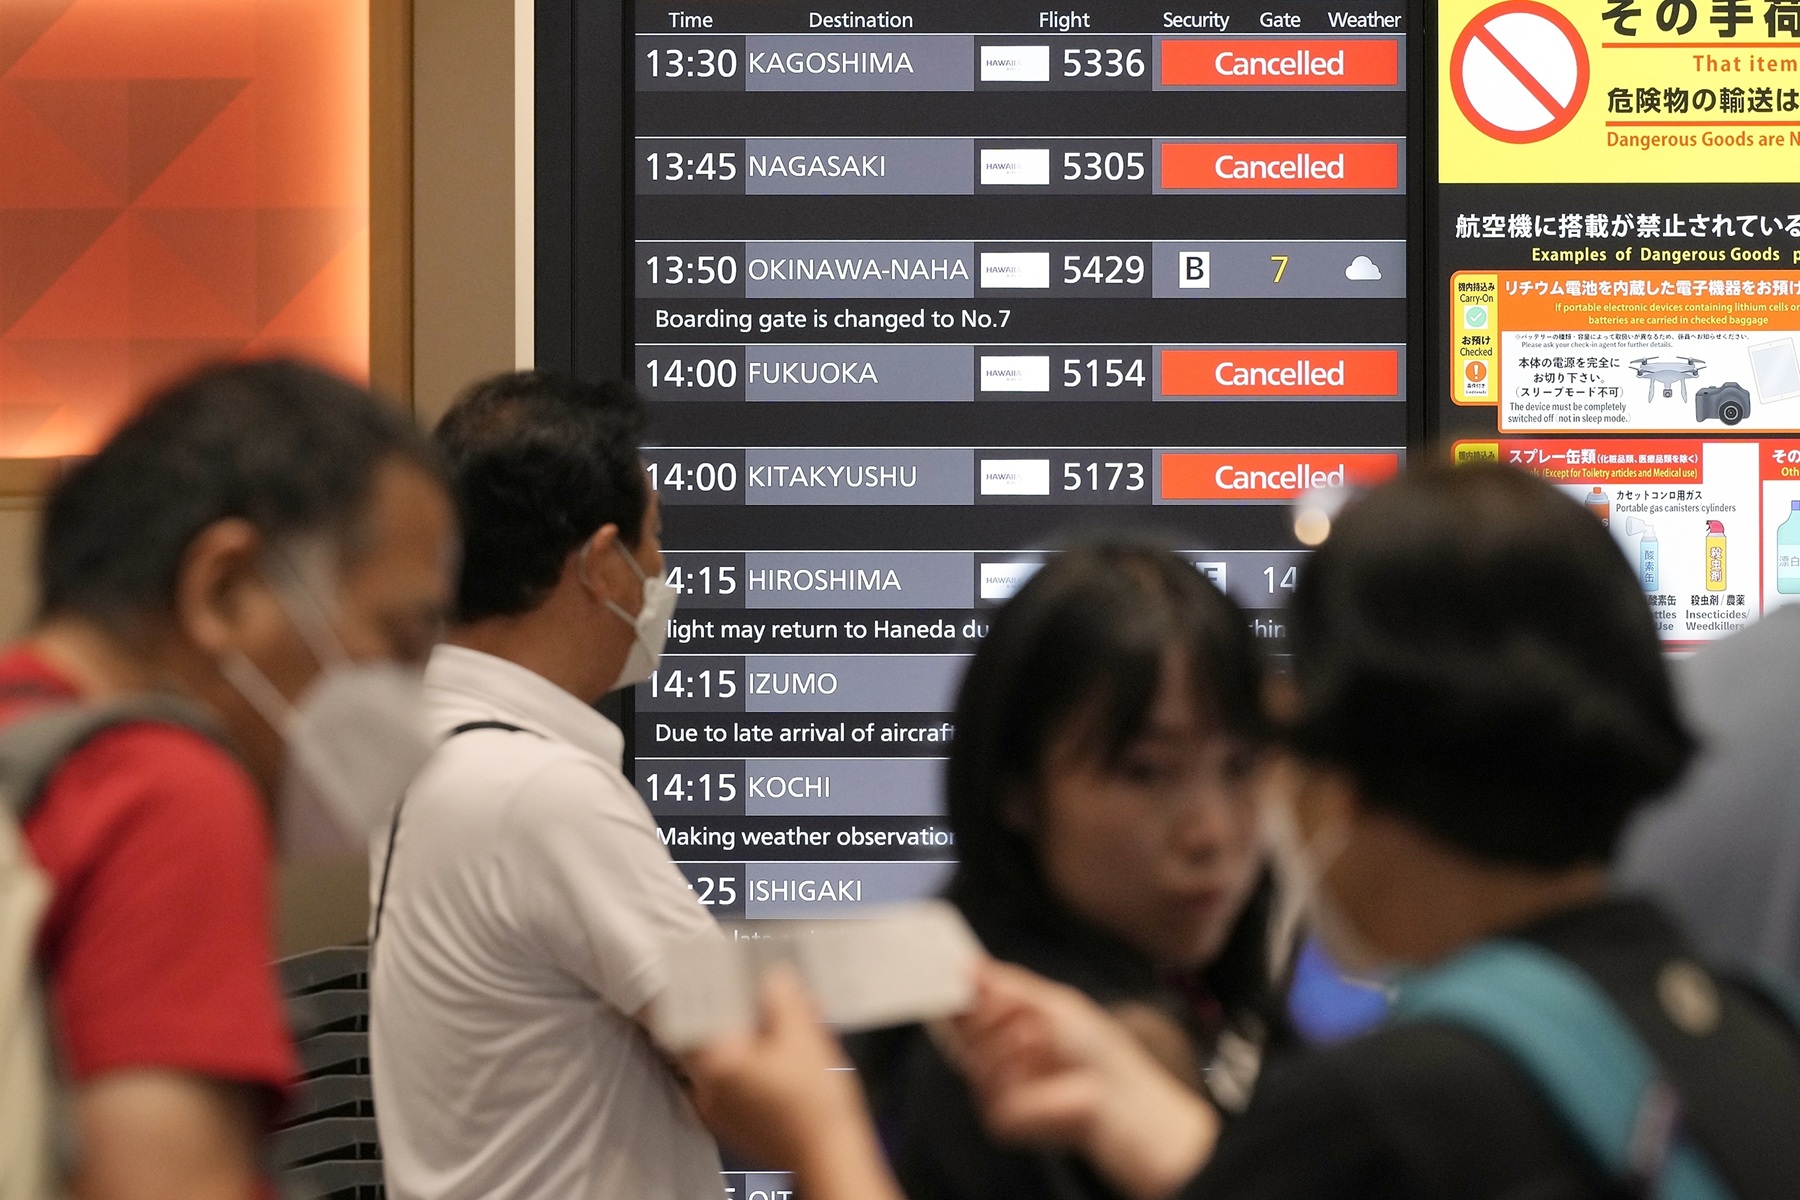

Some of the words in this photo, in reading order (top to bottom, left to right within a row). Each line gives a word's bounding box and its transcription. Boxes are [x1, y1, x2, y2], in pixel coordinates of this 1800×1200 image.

[669, 12, 713, 27] Time
[810, 12, 912, 27] Destination
[1040, 11, 1090, 31] Flight
[1164, 11, 1229, 31] Security
[1260, 12, 1300, 27] Gate
[1328, 11, 1401, 27] Weather
[1602, 0, 1800, 38] その手荷
[647, 50, 736, 77] 13:30
[750, 53, 913, 73] KAGOSHIMA
[1064, 49, 1144, 76] 5336
[1216, 50, 1343, 75] Cancelled
[1693, 55, 1740, 72] That
[1751, 55, 1797, 71] item
[1608, 87, 1799, 113] 危険物の輸送は
[1608, 132, 1696, 150] Dangerous
[1702, 131, 1753, 146] Goods
[1759, 135, 1784, 146] are
[647, 153, 736, 180] 13:45
[750, 156, 884, 176] NAGASAKI
[1064, 152, 1144, 180] 5305
[1216, 154, 1343, 178] Cancelled
[1456, 213, 1800, 238] 航空機に搭載が禁止されている
[1533, 247, 1606, 264] Examples
[1616, 247, 1632, 261] of
[1641, 248, 1725, 264] Dangerous
[1731, 247, 1779, 260] Goods
[647, 256, 736, 284] 13:50
[749, 259, 969, 280] OKINAWA-NAHA
[1064, 256, 1144, 283] 5429
[1184, 256, 1206, 282] B
[1272, 255, 1288, 283] 7
[1458, 282, 1495, 292] 機内持込み
[1460, 294, 1494, 305] Carry-On
[1555, 303, 1562, 312] If
[1564, 303, 1602, 314] portable
[1603, 303, 1648, 312] electronic
[1649, 303, 1683, 312] devices
[1685, 303, 1733, 314] containing
[1735, 303, 1767, 312] lithium
[1769, 303, 1789, 312] cells
[657, 309, 751, 332] Boarding
[759, 311, 806, 332] gate
[814, 309, 827, 327] is
[834, 309, 924, 332] changed
[931, 311, 954, 327] to
[962, 310, 1010, 327] No.7
[1588, 316, 1629, 325] batteries
[1647, 316, 1678, 325] carried
[1680, 316, 1689, 325] in
[1691, 316, 1728, 325] checked
[1729, 316, 1769, 327] baggage
[1461, 336, 1491, 346] お預け
[1460, 347, 1492, 356] Checked
[1518, 357, 1620, 369] 本体の電源を完全に
[647, 360, 736, 387] 14:00
[750, 363, 878, 383] FUKUOKA
[1064, 360, 1145, 386] 5154
[1216, 361, 1343, 385] Cancelled
[1533, 372, 1605, 384] お切り下さい。
[1510, 402, 1524, 411] The
[1525, 402, 1550, 411] device
[1552, 403, 1572, 411] must
[1573, 402, 1582, 411] be
[1584, 402, 1626, 413] completely
[1508, 414, 1542, 423] switched
[1543, 414, 1554, 423] off
[1573, 414, 1581, 423] in
[1582, 414, 1603, 424] sleep
[1509, 448, 1597, 464] スプレー缶類
[647, 463, 736, 491] 14:00
[750, 466, 916, 486] KITAKYUSHU
[1064, 463, 1144, 490] 5173
[1215, 463, 1344, 489] Cancelled
[1570, 467, 1581, 477] for
[1582, 468, 1610, 479] Toiletry
[1611, 468, 1637, 477] articles
[1638, 468, 1652, 477] and
[1653, 468, 1681, 477] Medical
[1682, 468, 1698, 479] use)
[1616, 490, 1703, 501] カセットコンロ用ガス
[1616, 503, 1649, 513] Portable
[1650, 505, 1663, 514] gas
[1644, 550, 1655, 583] 酸素缶
[1710, 547, 1723, 582] 殺虫剤
[665, 566, 737, 595] 4:15
[750, 570, 901, 591] HIROSHIMA
[1263, 567, 1297, 593] 14
[1654, 610, 1677, 619] ttles
[667, 619, 715, 643] light
[722, 625, 765, 643] may
[773, 622, 837, 638] return
[844, 622, 867, 638] to
[875, 619, 955, 638] Haneda
[962, 619, 989, 638] du
[1686, 622, 1745, 631] Weedkillers
[648, 669, 737, 698] 14:15
[750, 674, 838, 694] IZUMO
[657, 724, 697, 741] Due
[704, 725, 726, 741] to
[735, 723, 773, 741] late
[780, 723, 844, 741] arrival
[852, 723, 874, 741] of
[647, 774, 736, 801] 14:15
[750, 777, 830, 797] KOCHI
[657, 827, 736, 850] Making
[742, 827, 831, 845] weather
[687, 877, 737, 905] :25
[750, 881, 860, 901] ISHIGAKI
